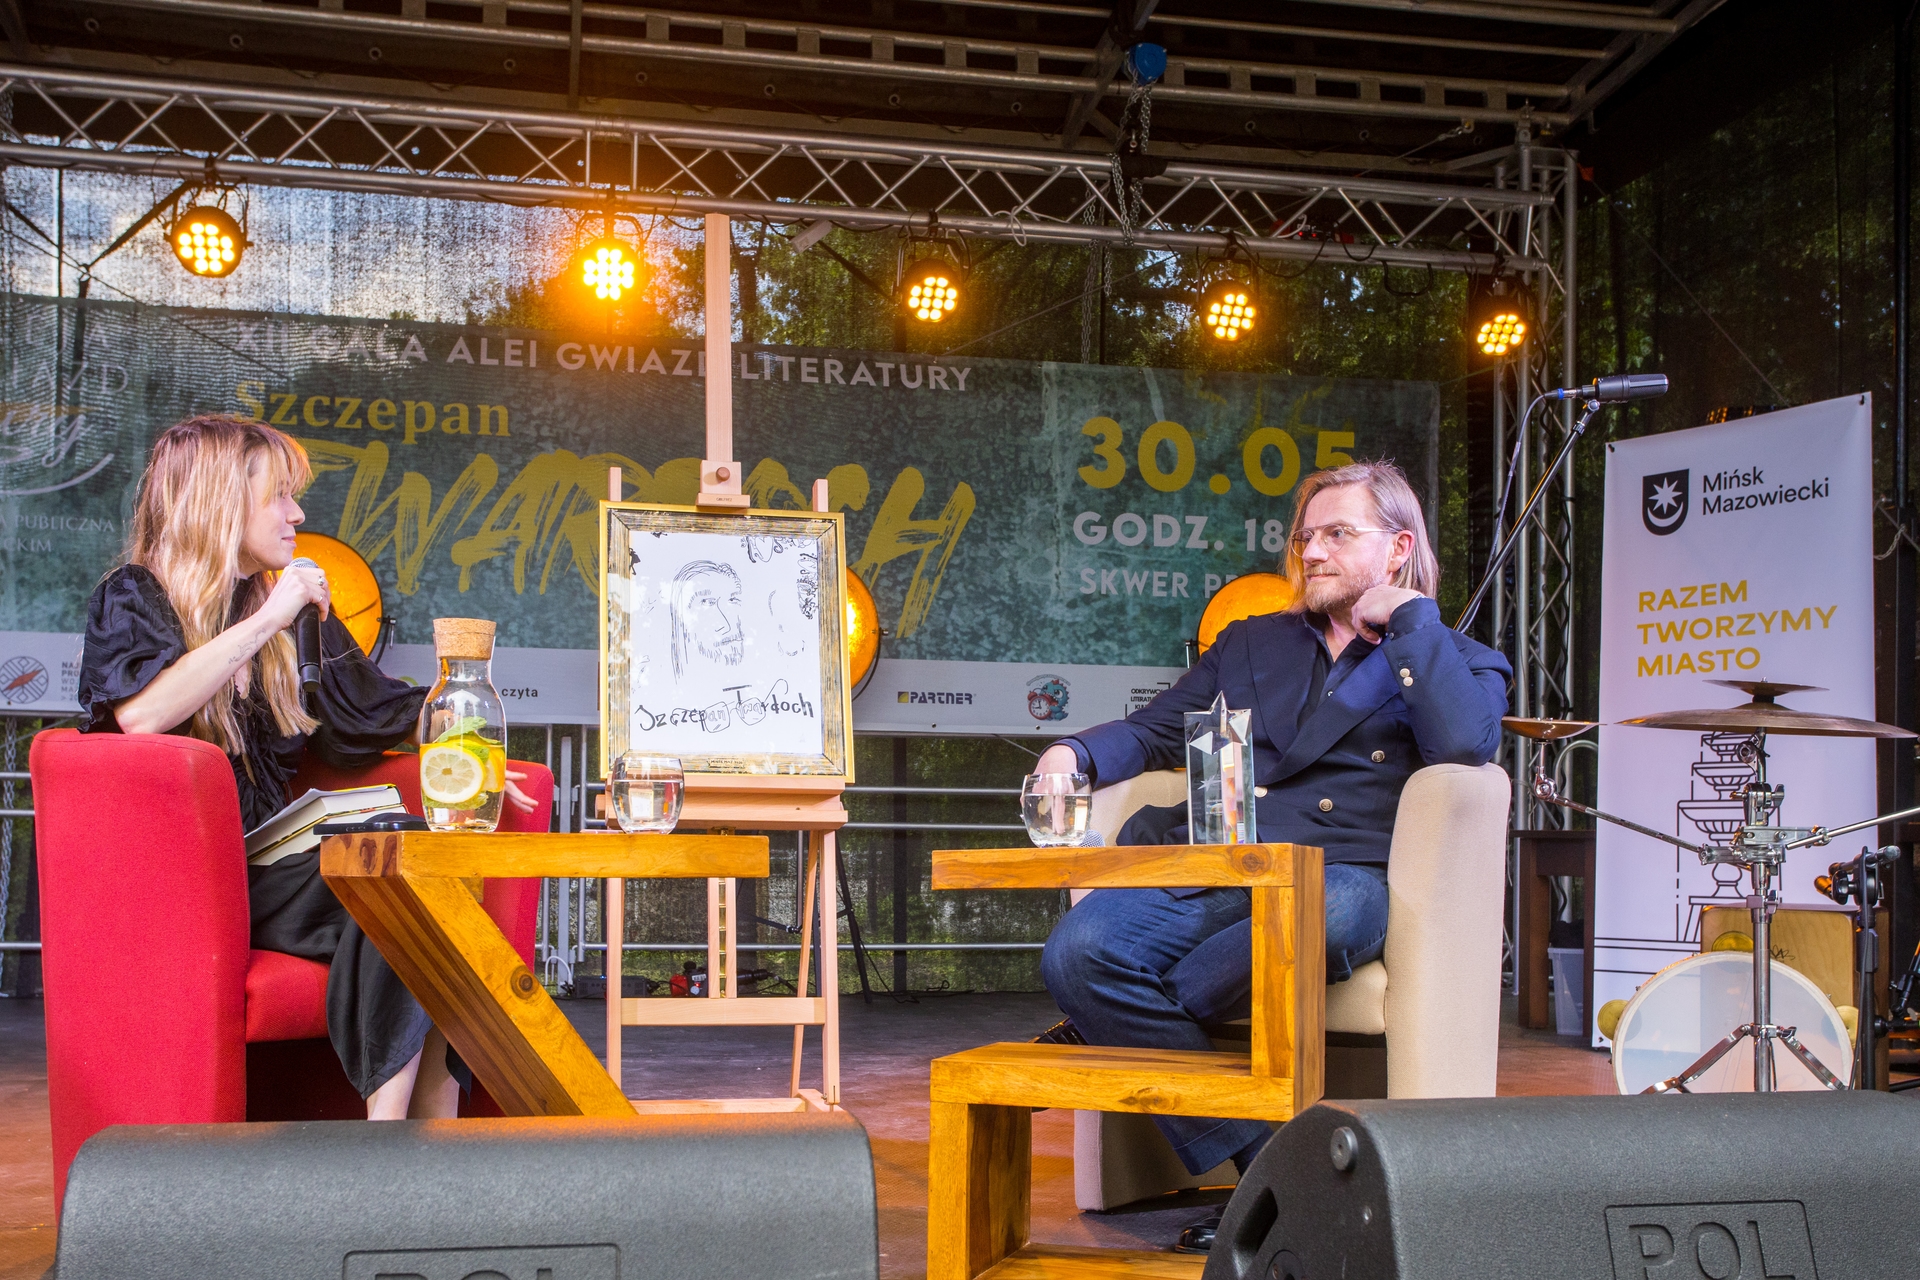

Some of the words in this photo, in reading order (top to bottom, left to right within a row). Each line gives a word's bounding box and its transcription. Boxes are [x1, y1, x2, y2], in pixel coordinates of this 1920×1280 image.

[446, 337, 537, 368] ALEI
[741, 353, 972, 391] LITERATURY
[236, 380, 511, 445] Szczepan
[1702, 466, 1765, 494] Mińsk
[1702, 477, 1830, 516] Mazowiecki
[14, 514, 115, 533] PUBLICZNA
[1073, 511, 1225, 552] GODZ.
[1244, 518, 1285, 554] 18
[1079, 567, 1191, 598] SKWER
[1637, 579, 1749, 613] RAZEM
[1636, 604, 1839, 645] TWORZYMY
[1636, 646, 1761, 678] MIASTO
[501, 687, 539, 700] czyta
[910, 691, 974, 705] PARTNER
[1628, 1220, 1797, 1280] POL
